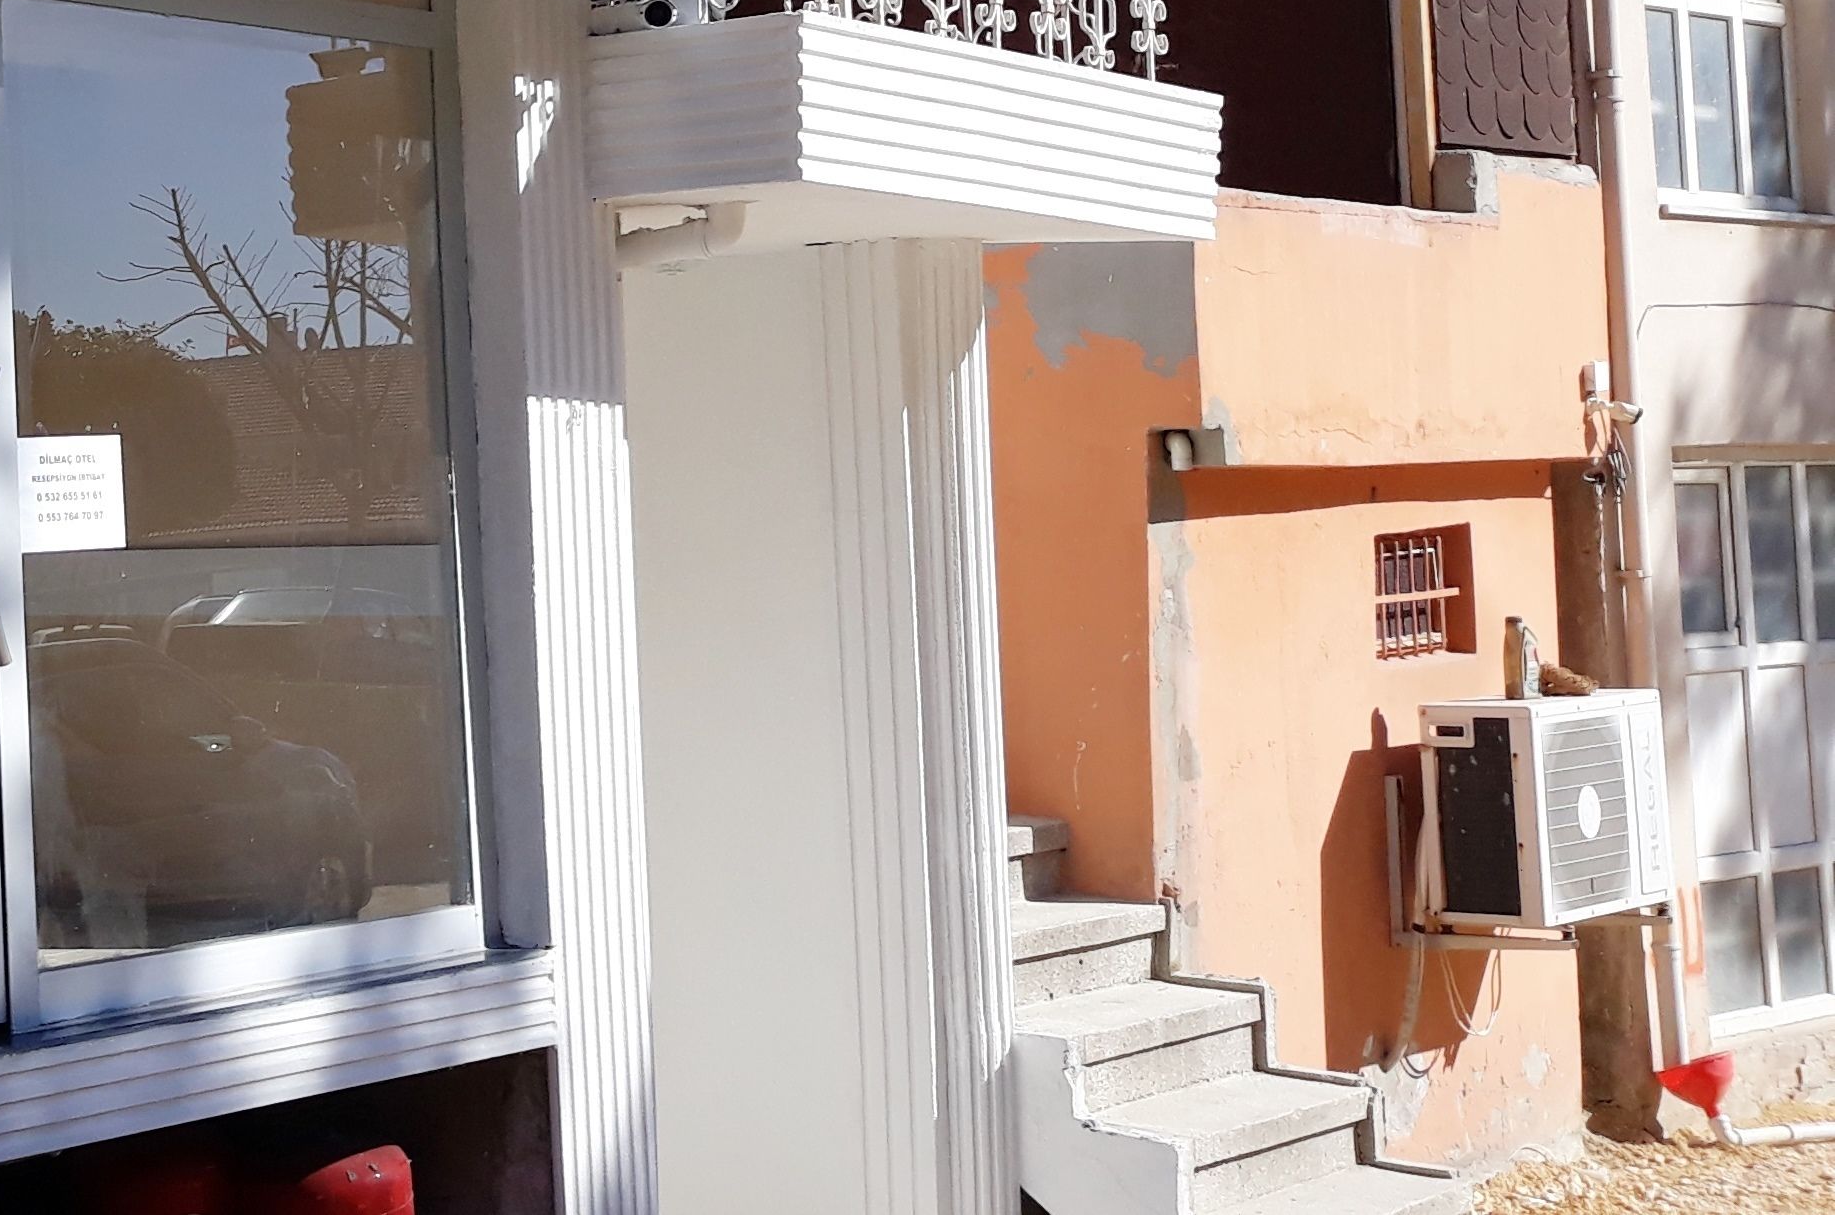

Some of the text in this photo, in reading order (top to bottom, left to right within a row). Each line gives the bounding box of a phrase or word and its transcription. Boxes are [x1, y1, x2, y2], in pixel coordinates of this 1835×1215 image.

[39, 453, 96, 464] DİLMAÇ OTEL
[37, 492, 42, 502] 0
[45, 492, 60, 502] 532
[38, 513, 43, 522] 0
